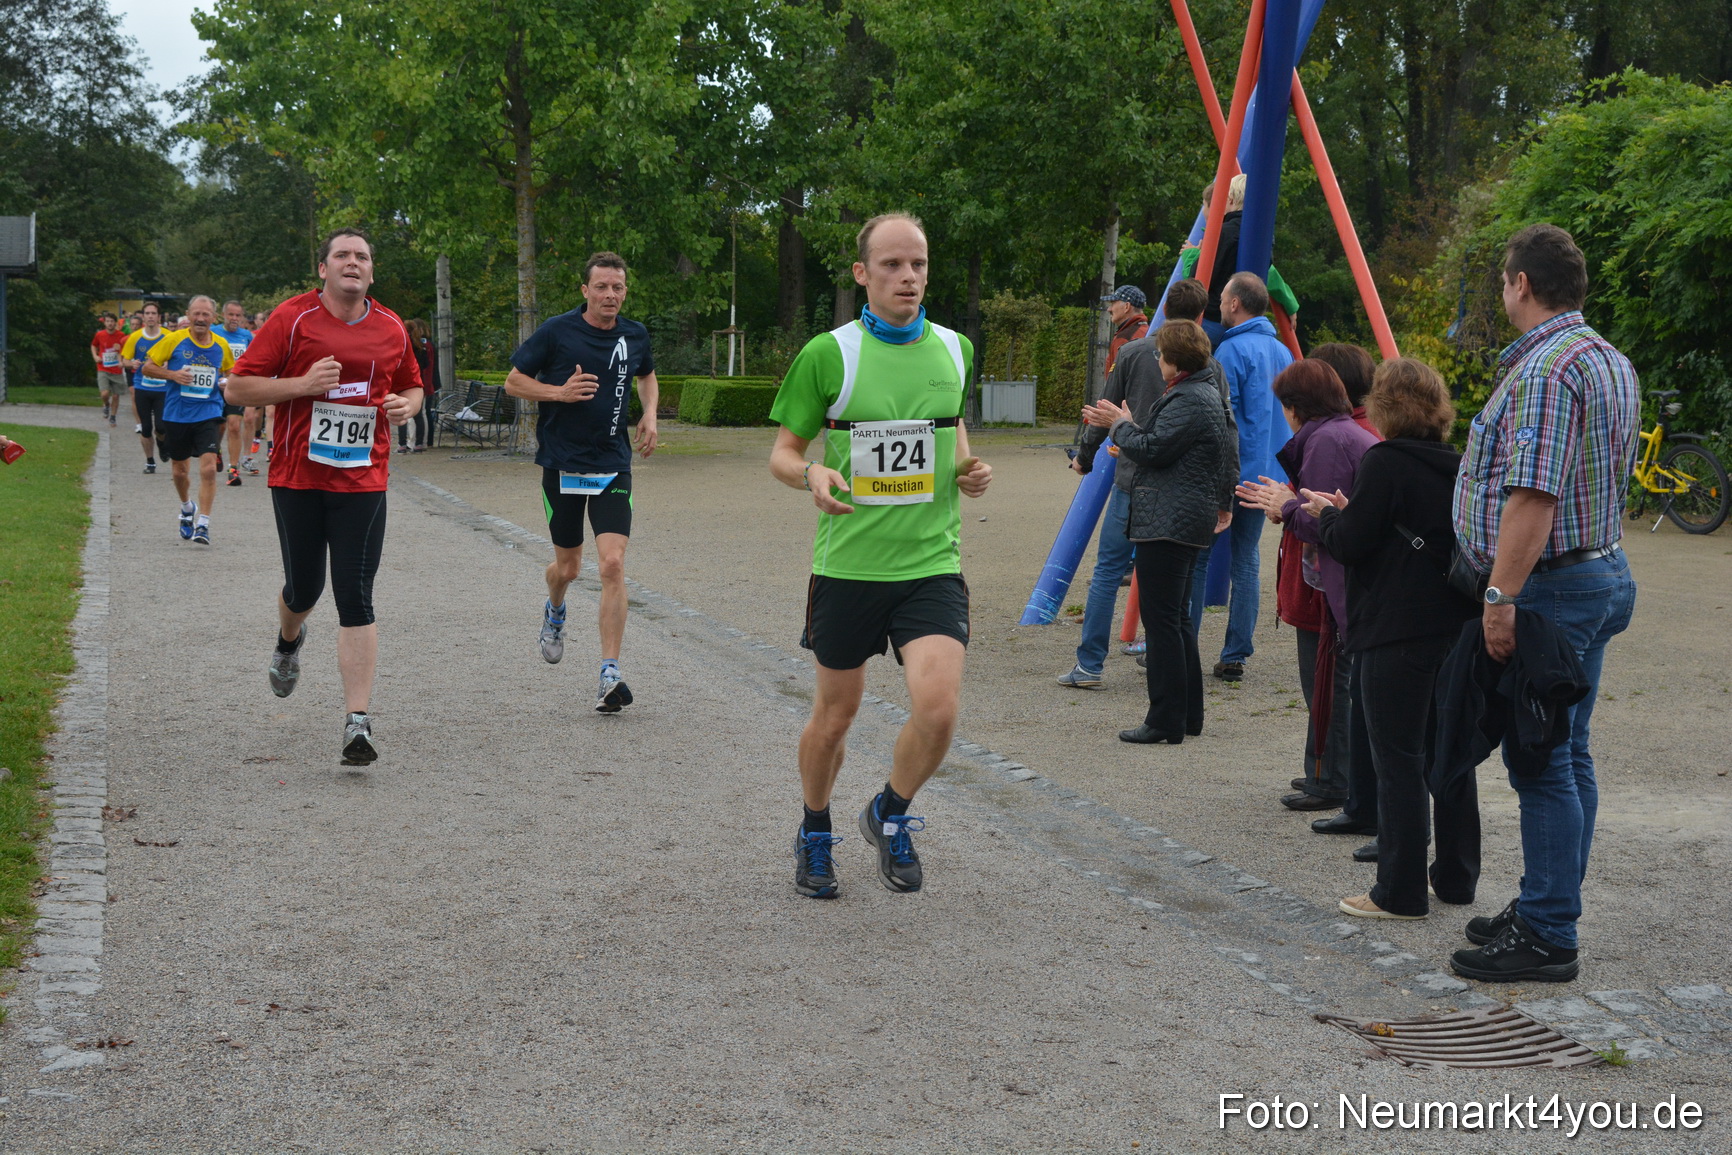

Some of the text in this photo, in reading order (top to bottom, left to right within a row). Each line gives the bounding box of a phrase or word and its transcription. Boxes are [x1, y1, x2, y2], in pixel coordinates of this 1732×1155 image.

[339, 386, 358, 395] DEHN
[314, 407, 369, 419] PARTL Neumarkt
[317, 418, 370, 444] 2194
[852, 427, 927, 438] PARTL Neumarkt
[333, 449, 351, 459] Uwe
[871, 439, 926, 473] 124
[579, 479, 600, 487] Frank
[872, 480, 924, 493] Christian
